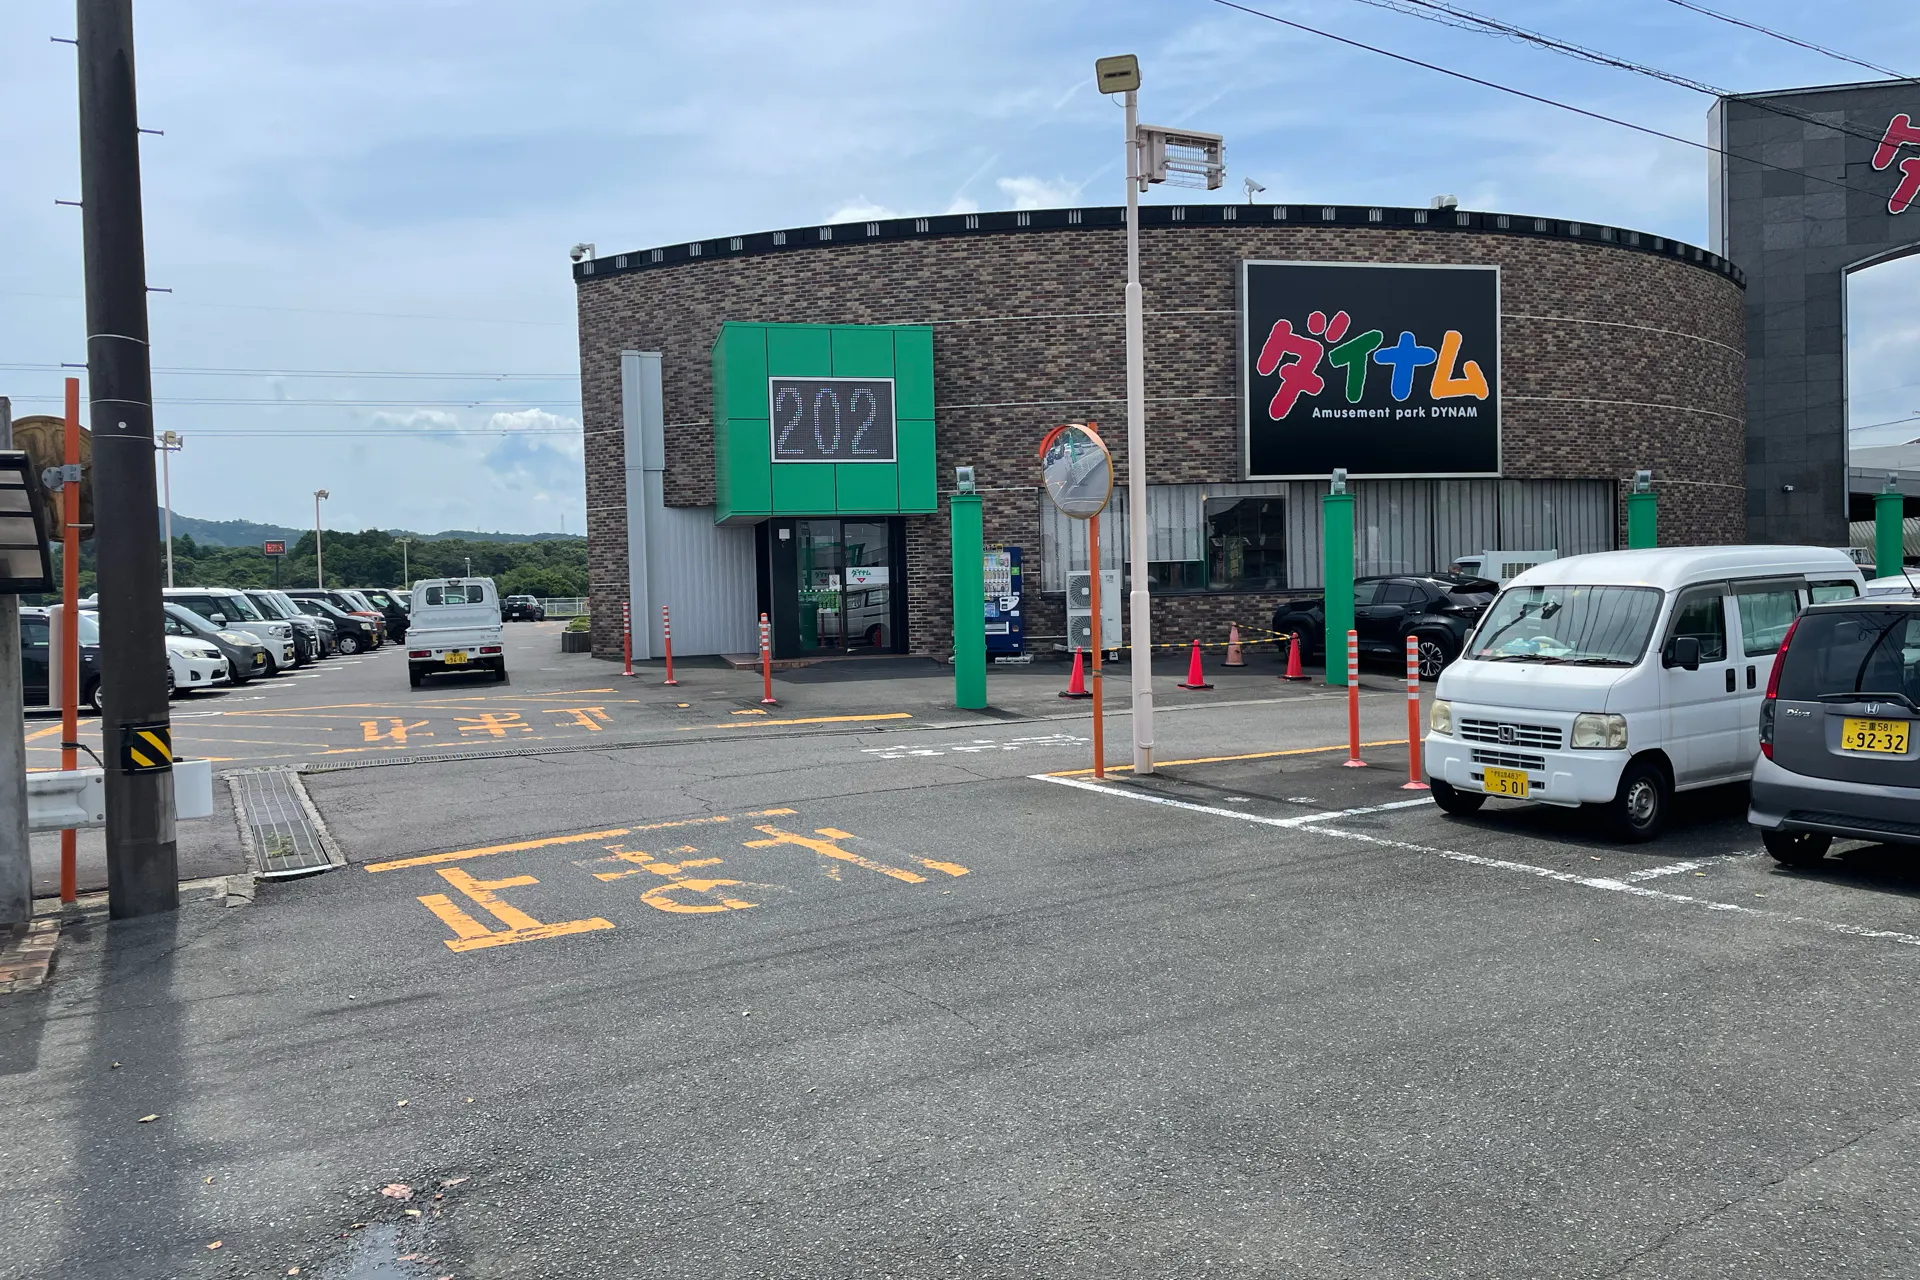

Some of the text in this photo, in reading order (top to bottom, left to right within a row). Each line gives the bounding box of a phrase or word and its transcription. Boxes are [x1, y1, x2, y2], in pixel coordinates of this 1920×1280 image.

[1257, 310, 1489, 421] ダイナム
[776, 387, 877, 454] 202
[1312, 406, 1478, 420] Amusement park DYNAM
[851, 568, 871, 577] ダイナム
[1859, 721, 1893, 732] 三重581
[1856, 732, 1904, 751] 92-32
